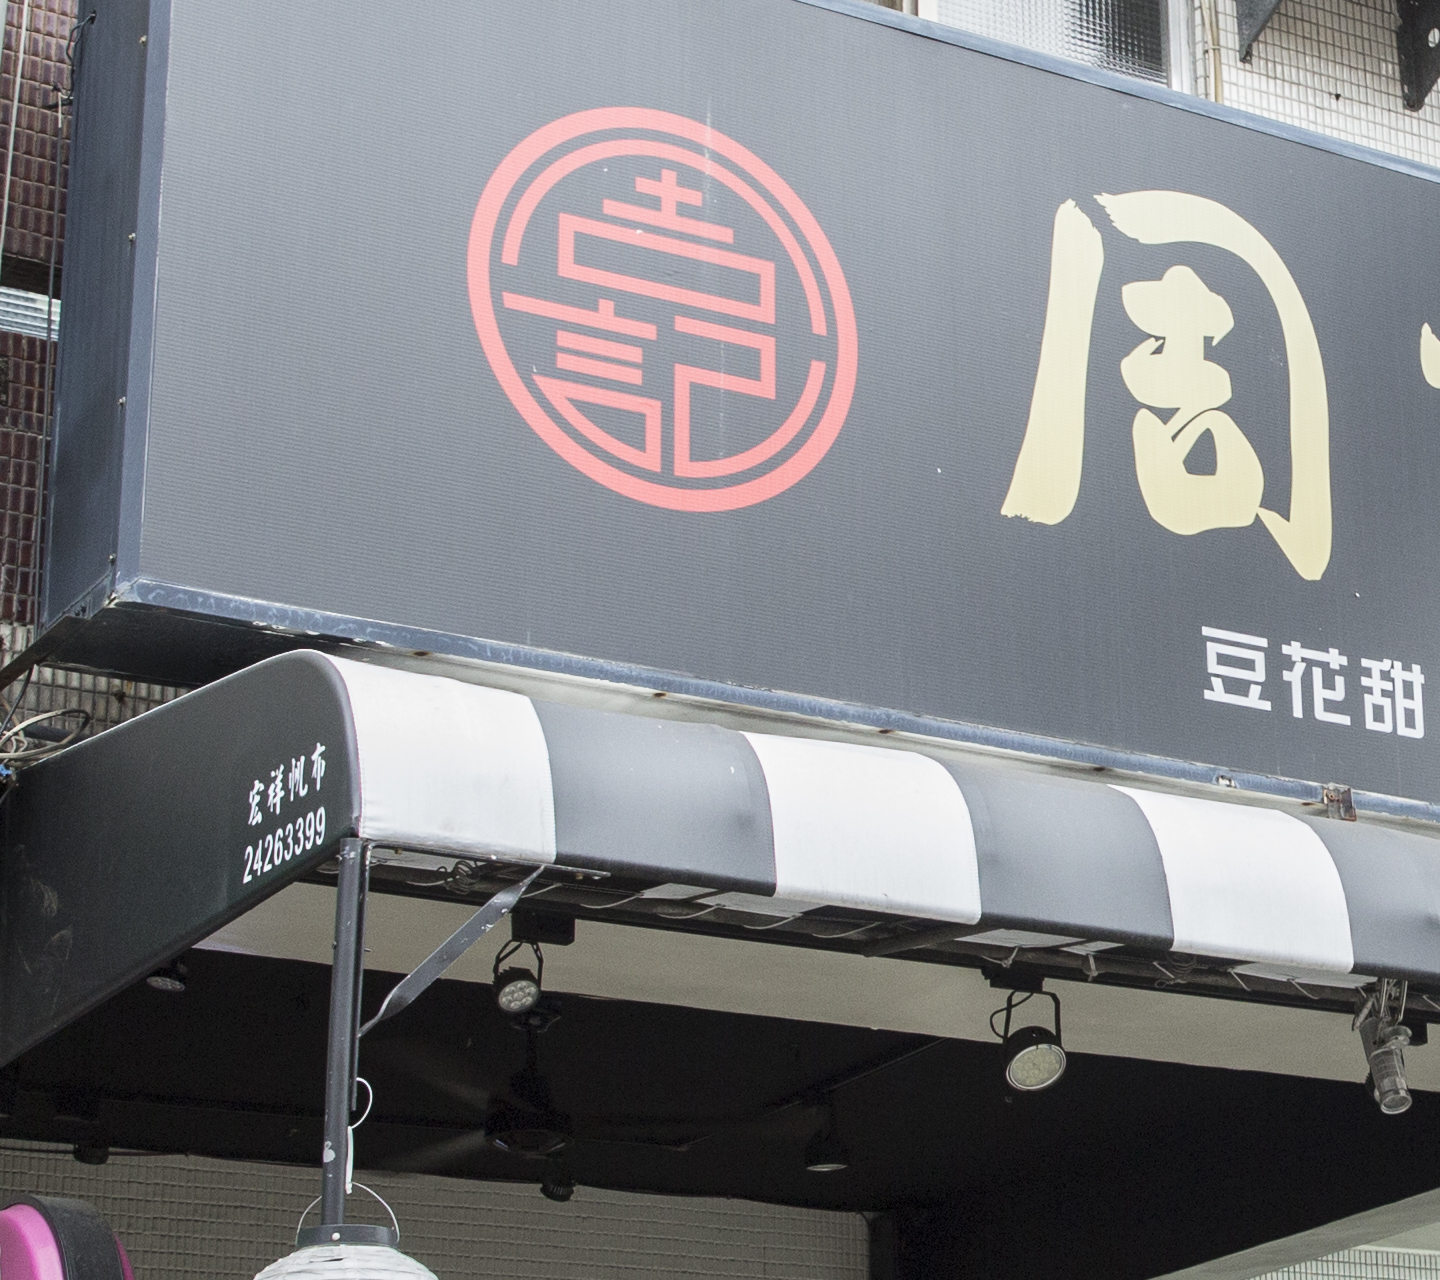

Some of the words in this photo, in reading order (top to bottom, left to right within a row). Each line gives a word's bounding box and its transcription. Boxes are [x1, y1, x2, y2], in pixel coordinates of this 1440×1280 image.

[248, 742, 326, 825] 宏祥帆布
[243, 806, 326, 884] 24263399
